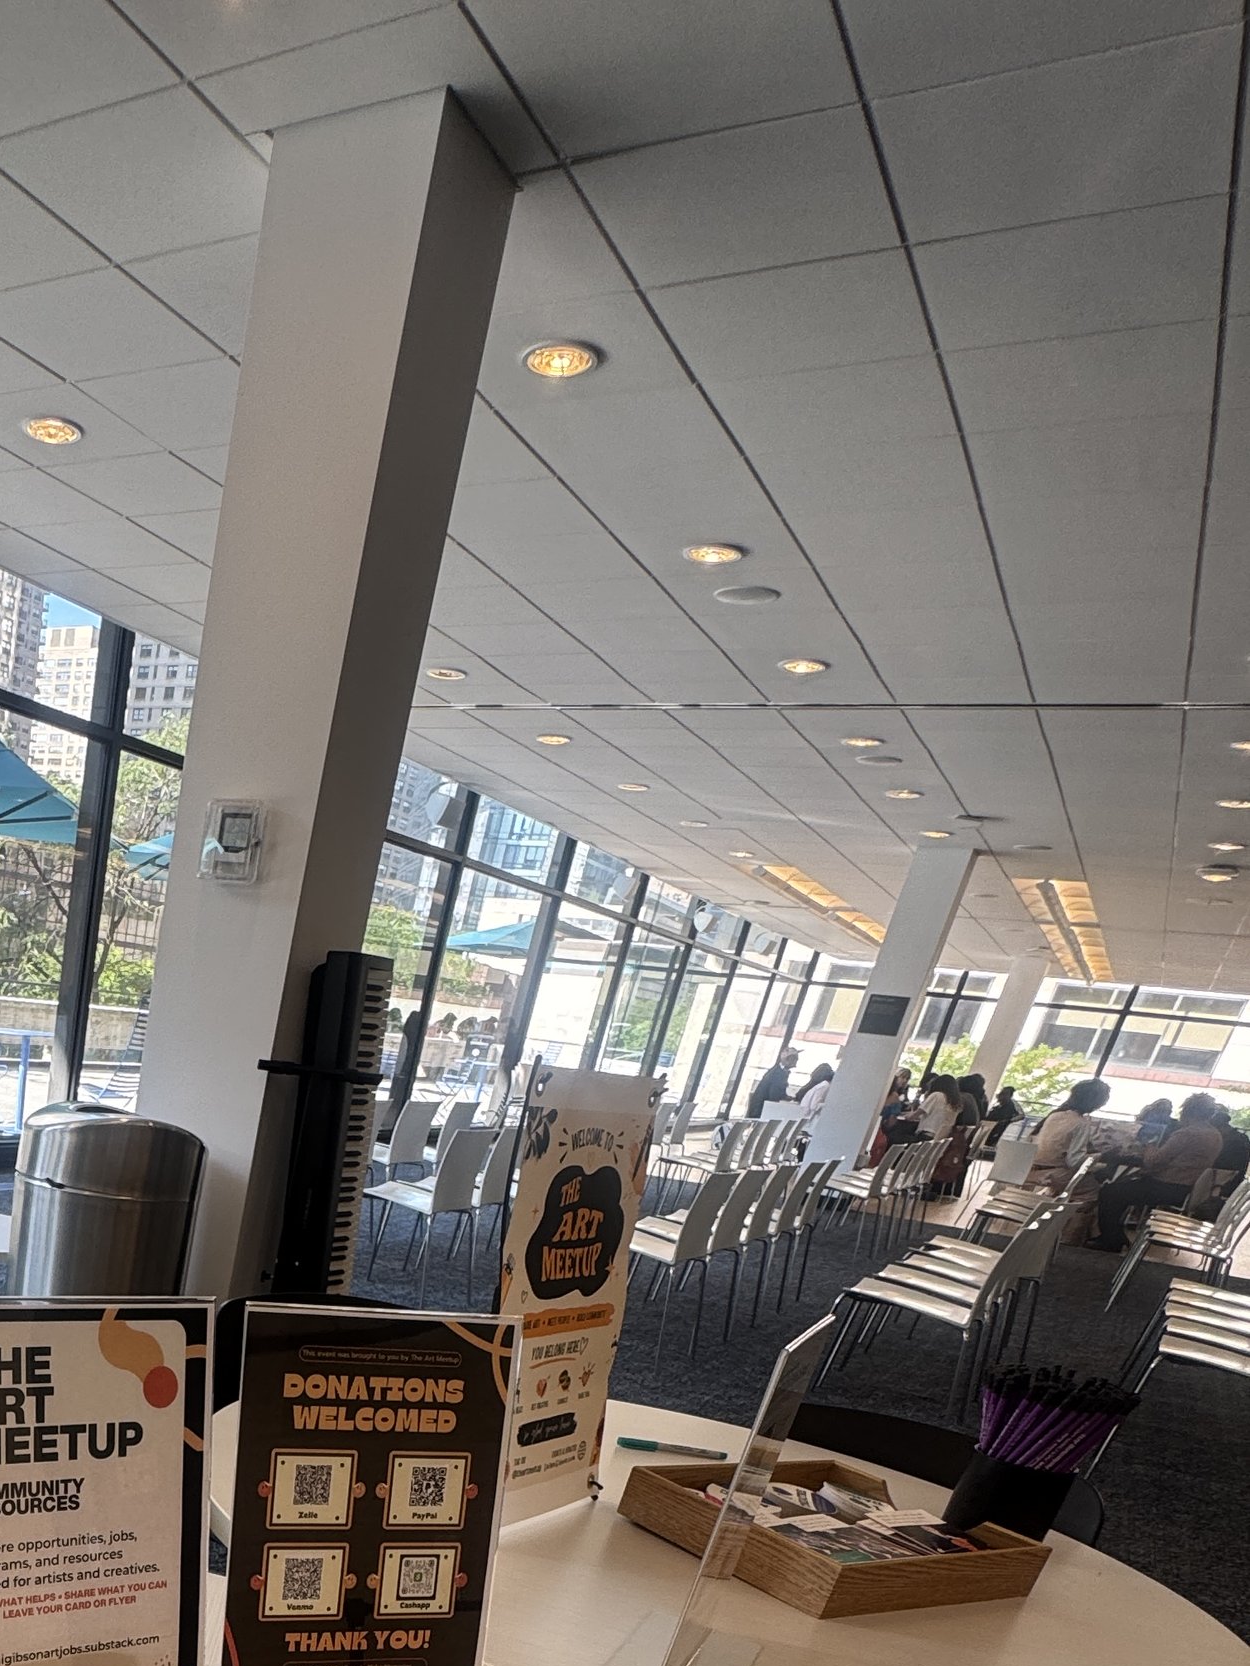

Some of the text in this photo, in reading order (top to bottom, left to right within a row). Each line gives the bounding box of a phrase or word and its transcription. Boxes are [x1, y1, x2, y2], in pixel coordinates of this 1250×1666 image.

[571, 1128, 615, 1152] WELCOME TO
[560, 1176, 582, 1207] THE
[552, 1208, 604, 1242] ART
[541, 1243, 603, 1282] MEETUP
[283, 1373, 465, 1404] DONATIONS
[293, 1404, 457, 1433] WELCOMED
[411, 1512, 438, 1521] PayPal
[17, 1532, 107, 1554] opportunities,
[107, 1529, 138, 1546] jobs,
[34, 1553, 60, 1568] and
[63, 1550, 123, 1565] resources
[12, 1575, 32, 1588] for
[34, 1571, 74, 1586] artists
[76, 1567, 101, 1581] and
[102, 1562, 160, 1578] creatives.
[25, 1592, 57, 1605] HELPS
[63, 1588, 96, 1601] SHARE
[97, 1584, 126, 1596] WHAT
[127, 1582, 147, 1593] YOU
[147, 1580, 168, 1590] CAN
[2, 1595, 137, 1620] LEAVE YOUR CARD OR FLYER
[399, 1601, 431, 1611] Cashapp
[284, 1629, 431, 1652] THANK YOU!
